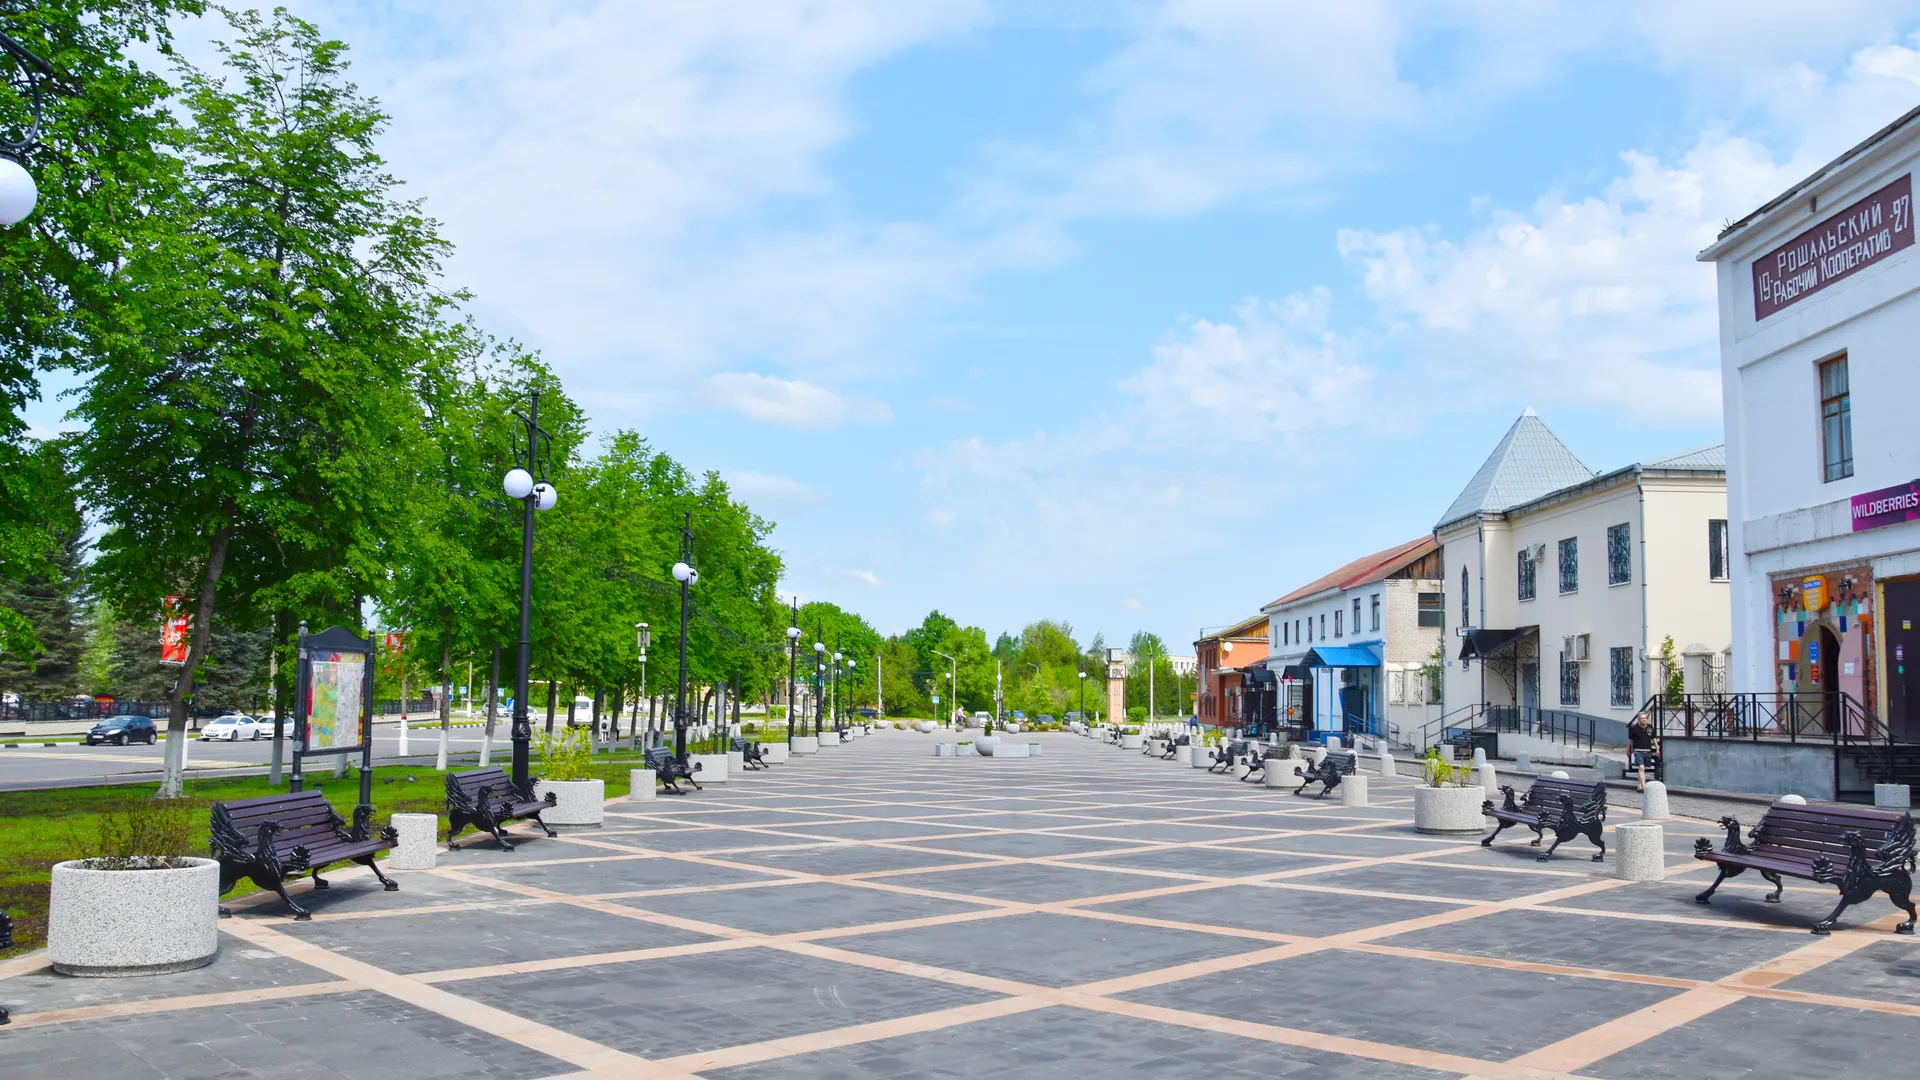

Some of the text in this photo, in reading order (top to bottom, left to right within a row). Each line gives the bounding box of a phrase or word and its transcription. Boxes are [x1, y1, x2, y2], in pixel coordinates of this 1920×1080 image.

[1774, 228, 1892, 305] РАБОЧИЙ КООПЕРАТИВ
[1777, 201, 1882, 278] РОШАЛЬСКИЙ
[1852, 492, 1919, 519] WILDBERRIES
